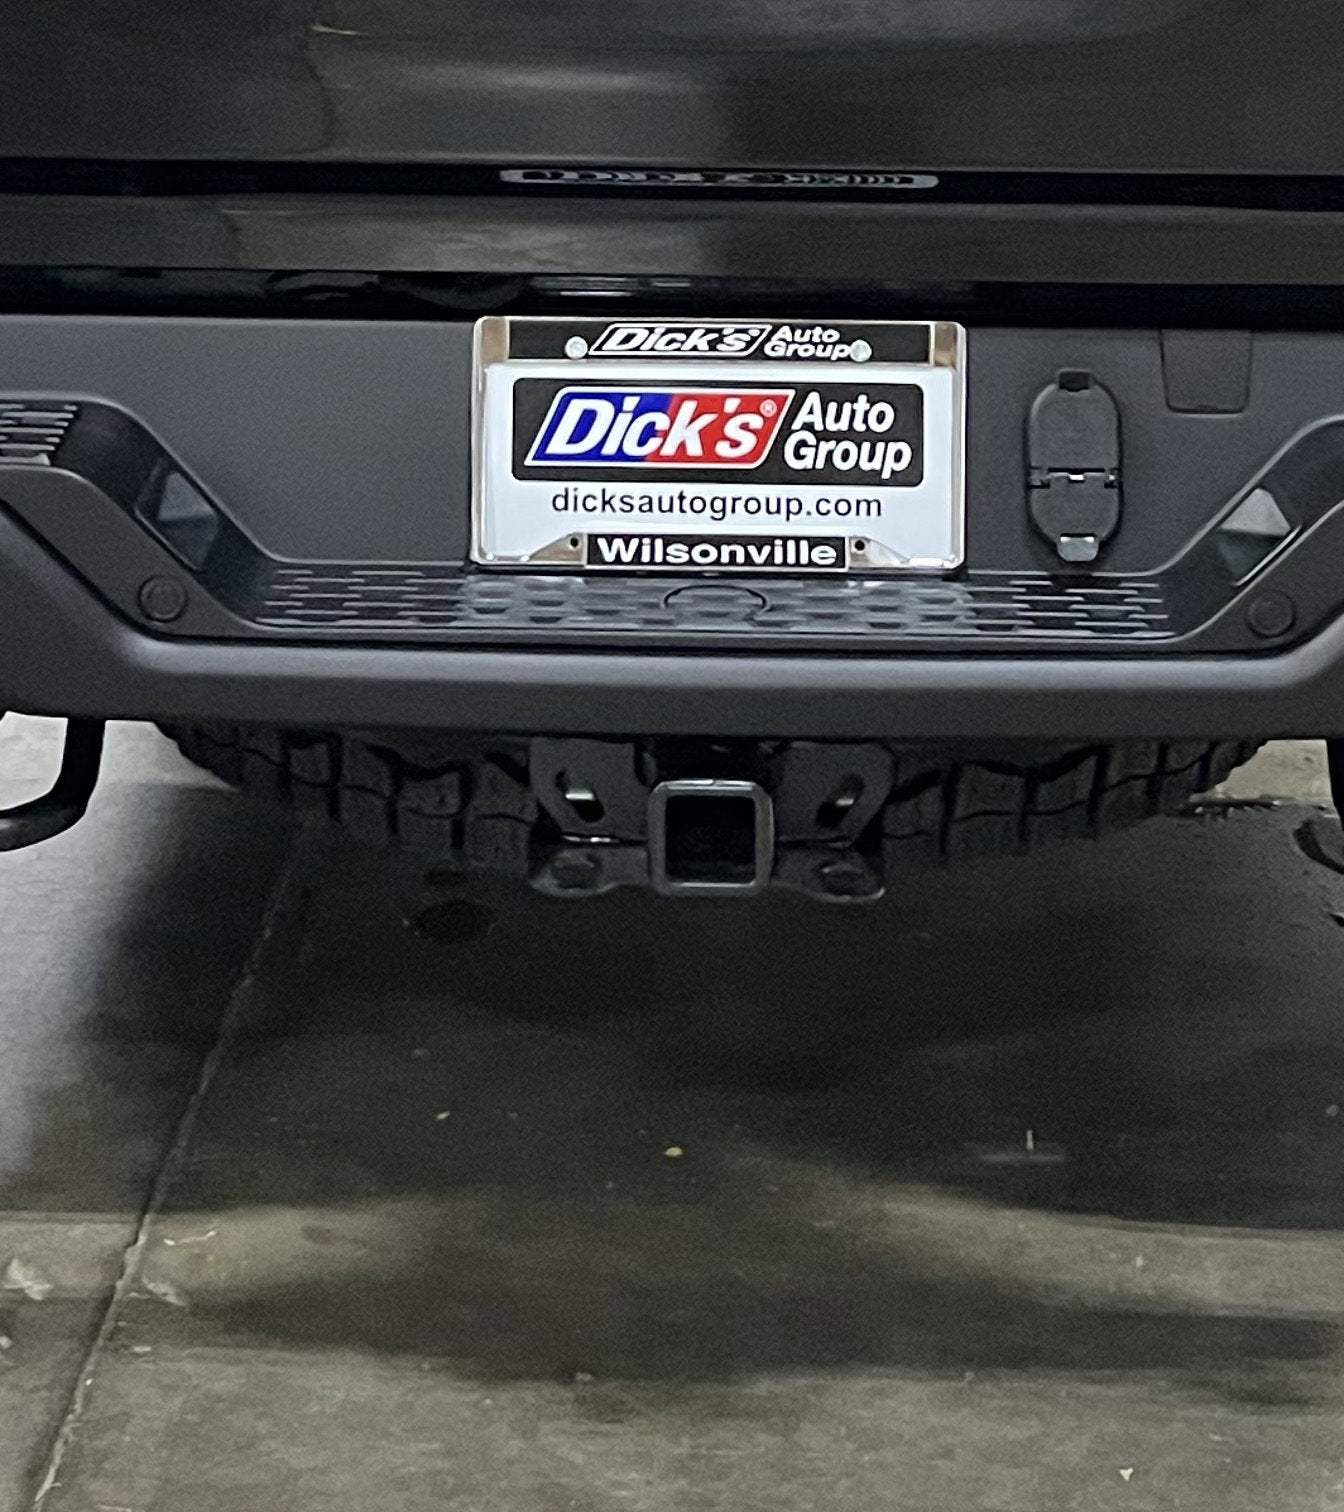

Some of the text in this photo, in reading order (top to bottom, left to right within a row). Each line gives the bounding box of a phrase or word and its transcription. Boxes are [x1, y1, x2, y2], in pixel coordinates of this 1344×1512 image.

[773, 324, 841, 343] Auto
[763, 340, 852, 361] Group
[790, 391, 895, 433] Auto
[783, 432, 913, 479] Group
[552, 487, 883, 521] dicksautogroup.com
[598, 537, 837, 566] Wilsonville
